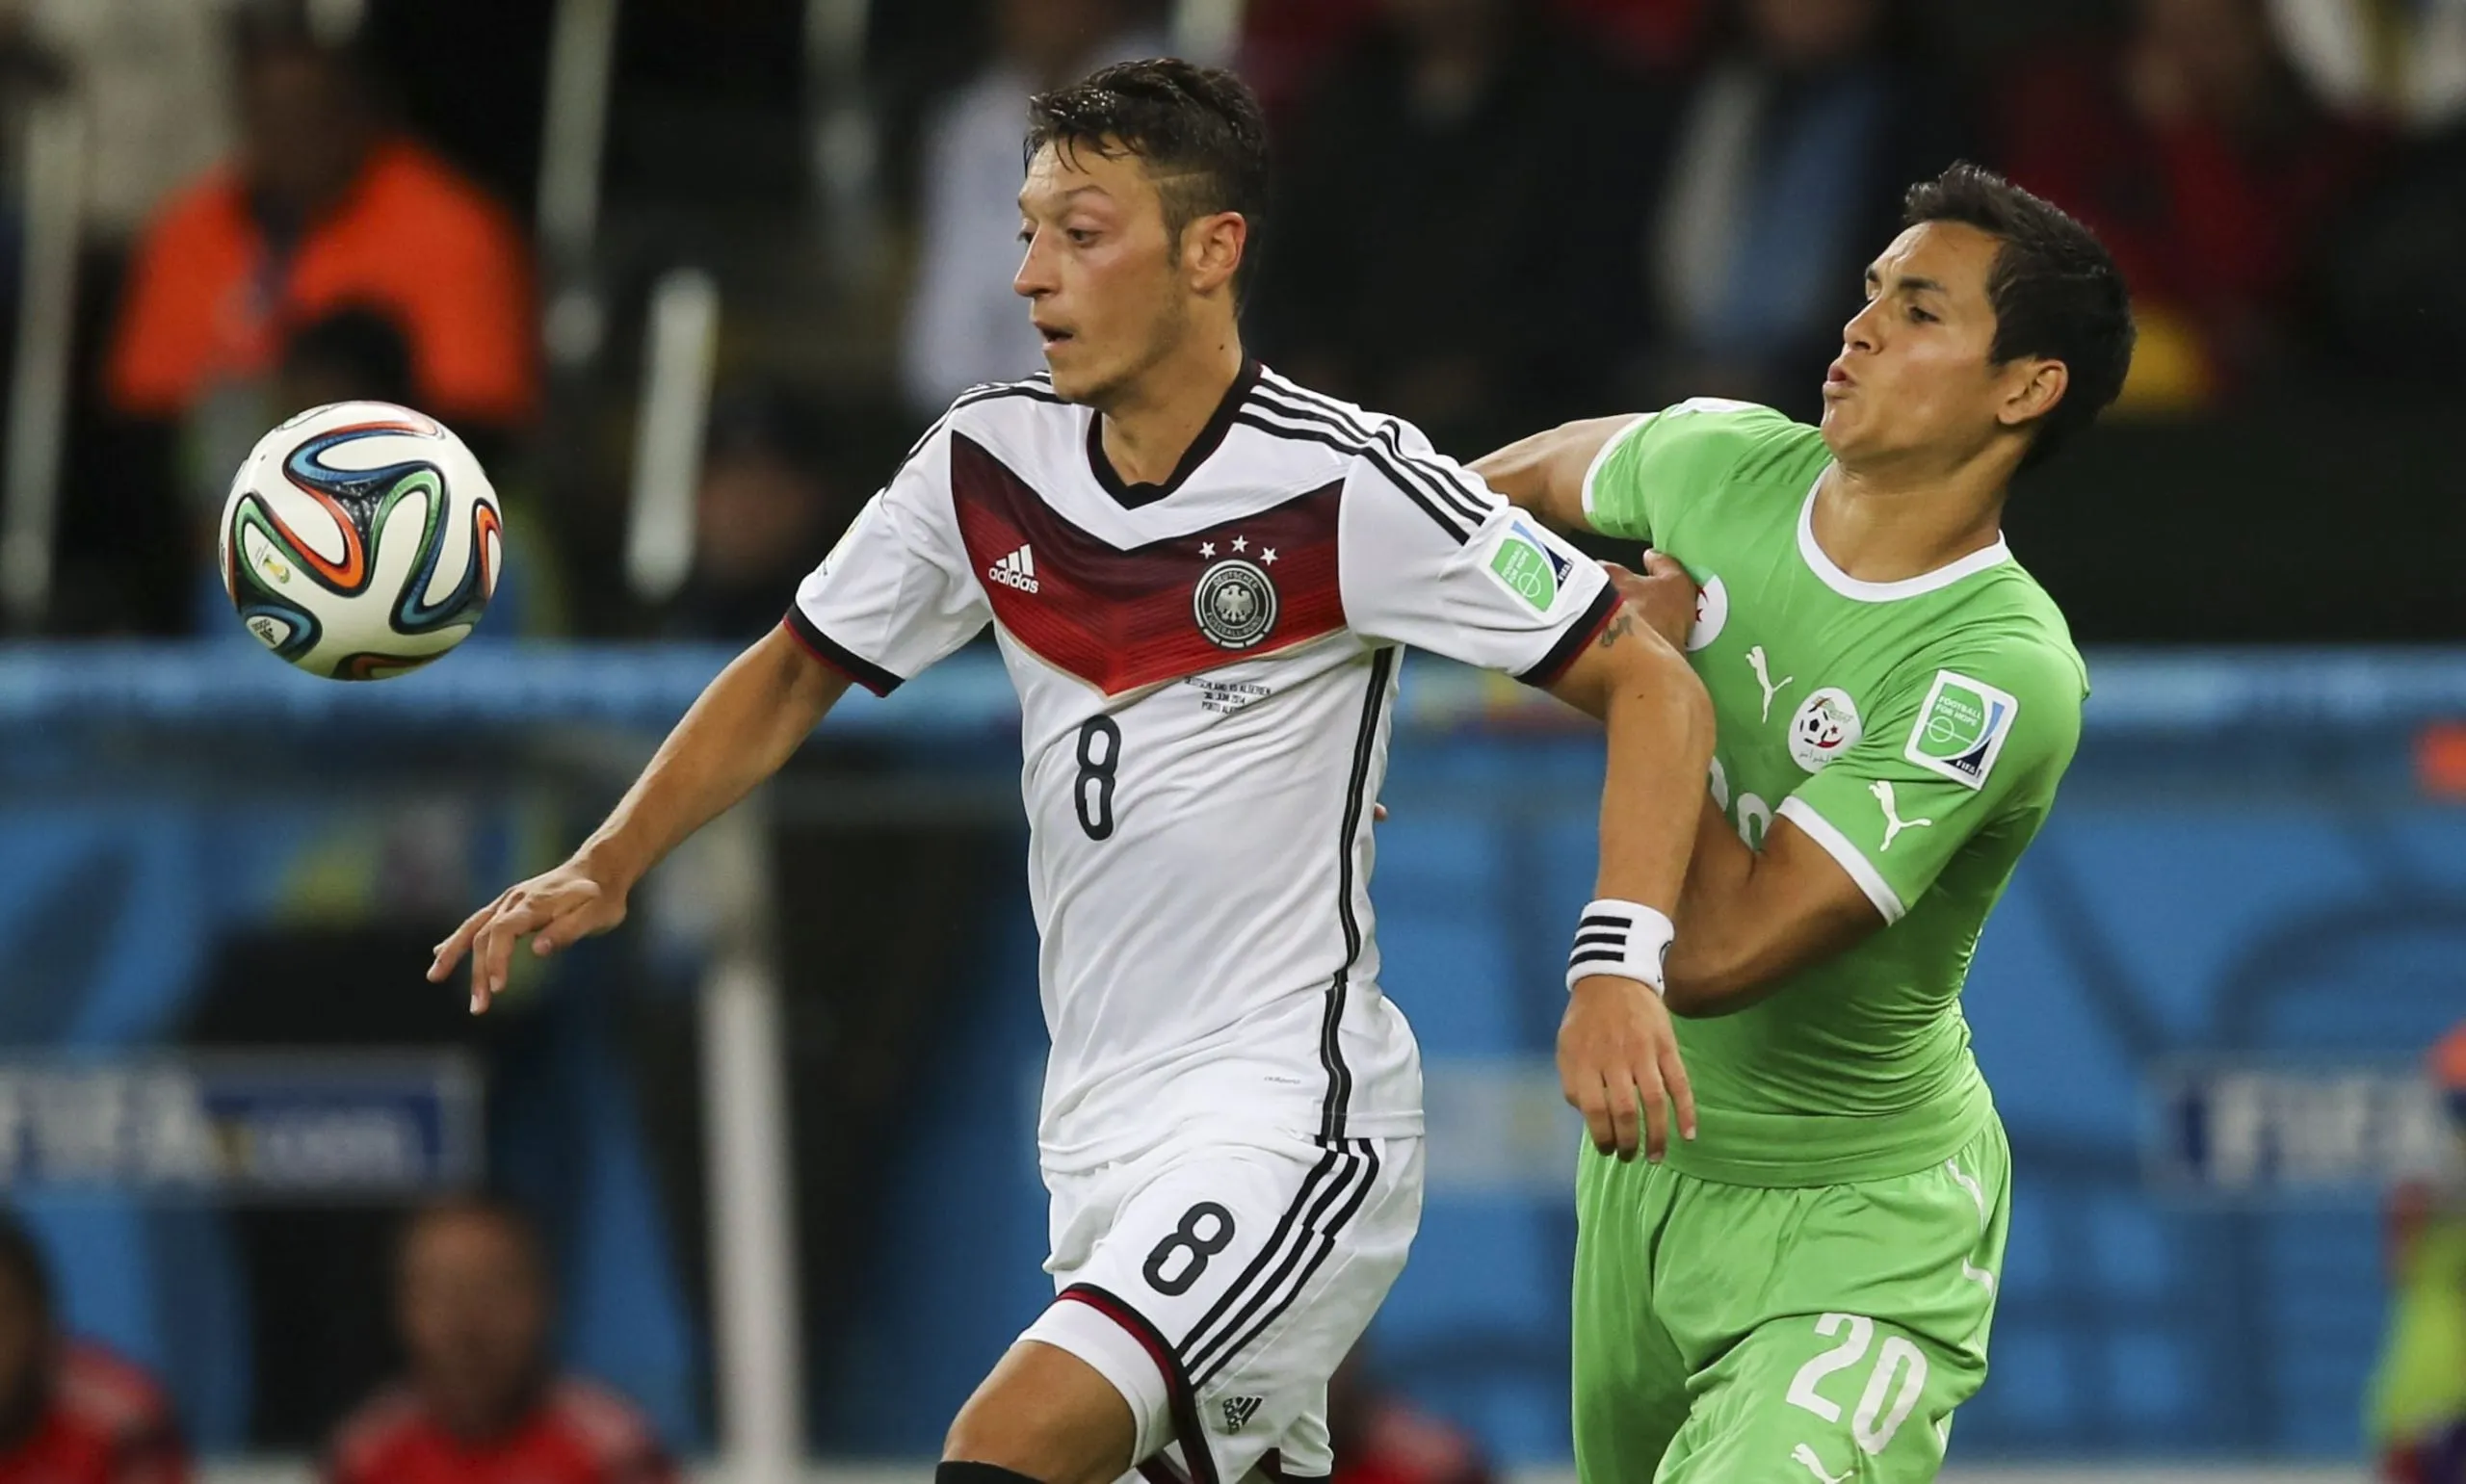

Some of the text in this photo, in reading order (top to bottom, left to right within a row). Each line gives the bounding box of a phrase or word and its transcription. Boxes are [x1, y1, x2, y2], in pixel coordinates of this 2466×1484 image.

[988, 567, 1039, 593] adidas
[1934, 704, 1978, 727] FOR HOPE
[1937, 695, 1982, 719] FOOTBALL
[1075, 714, 1121, 841] 8
[1956, 760, 1977, 773] FIFA
[1142, 1201, 1236, 1296] 8
[1786, 1312, 1928, 1455] 20
